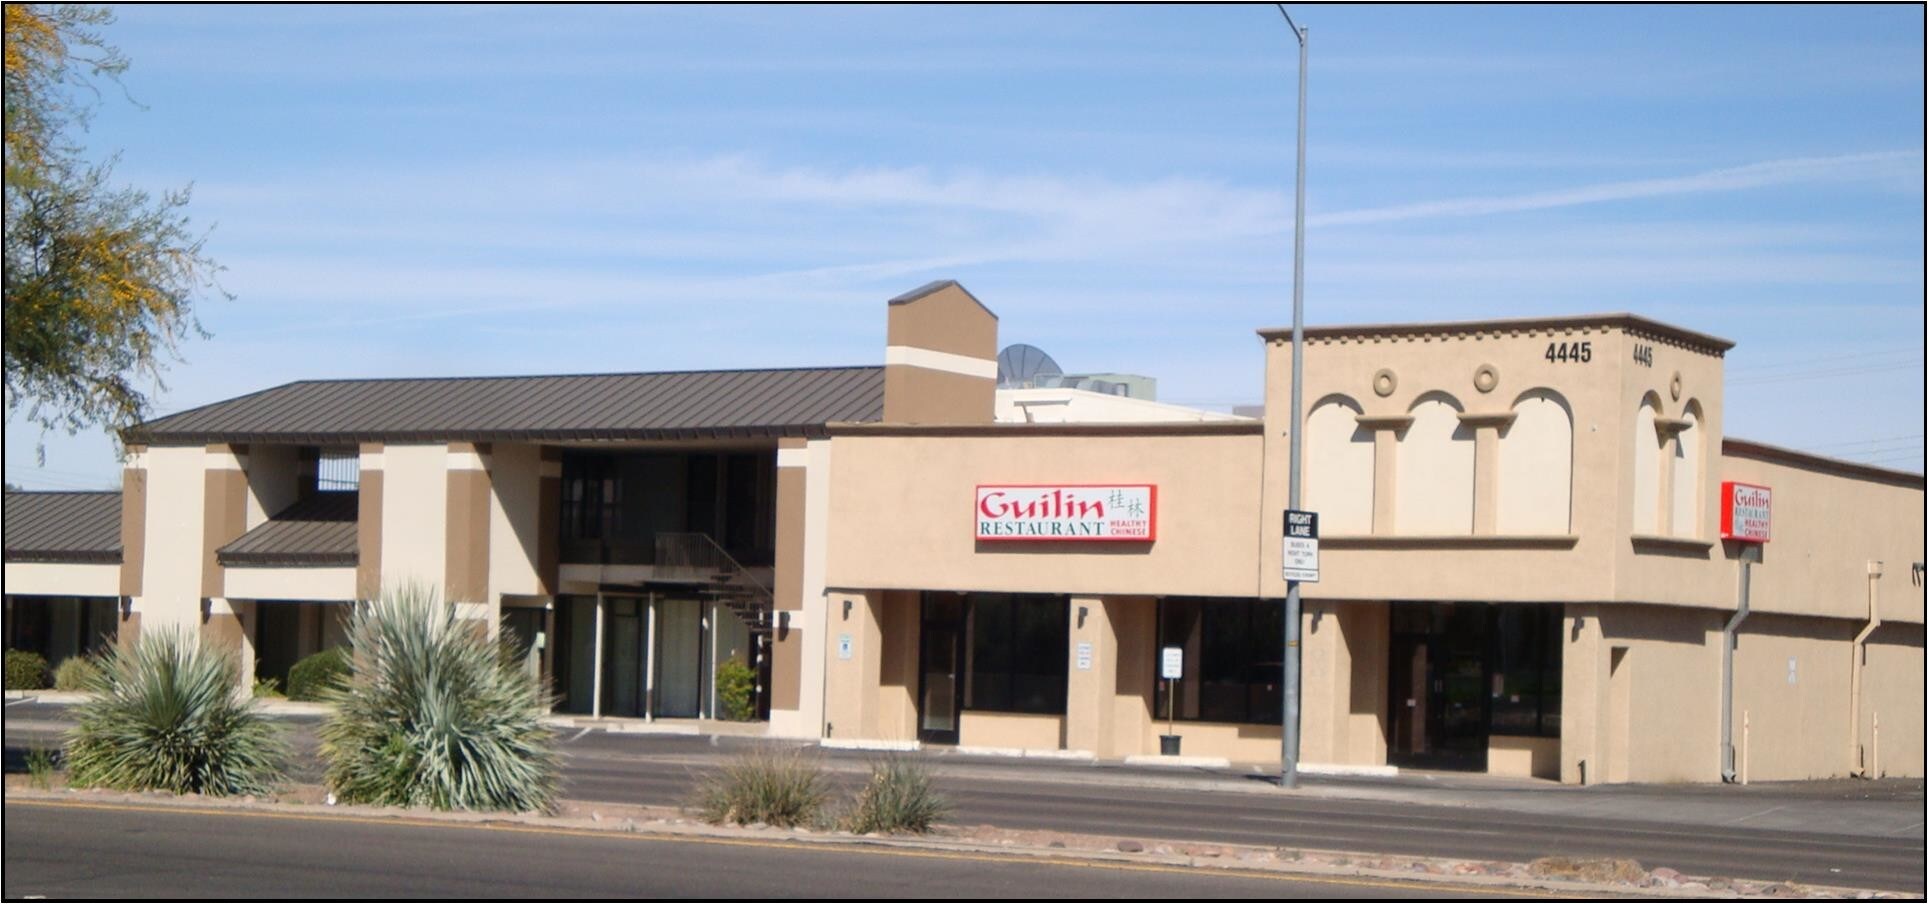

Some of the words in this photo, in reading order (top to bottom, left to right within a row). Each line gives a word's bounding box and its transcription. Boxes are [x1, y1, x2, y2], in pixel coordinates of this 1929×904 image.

[1545, 342, 1592, 363] 4445
[1633, 343, 1653, 368] 4445
[980, 490, 1105, 519] Guilin
[1107, 488, 1145, 518] 桂林
[1735, 488, 1769, 509] Guilin
[980, 521, 1105, 536] RESTAURANT
[1289, 513, 1312, 525] RIGHT
[1110, 528, 1146, 536] CHINESE
[1290, 525, 1311, 537] LANE
